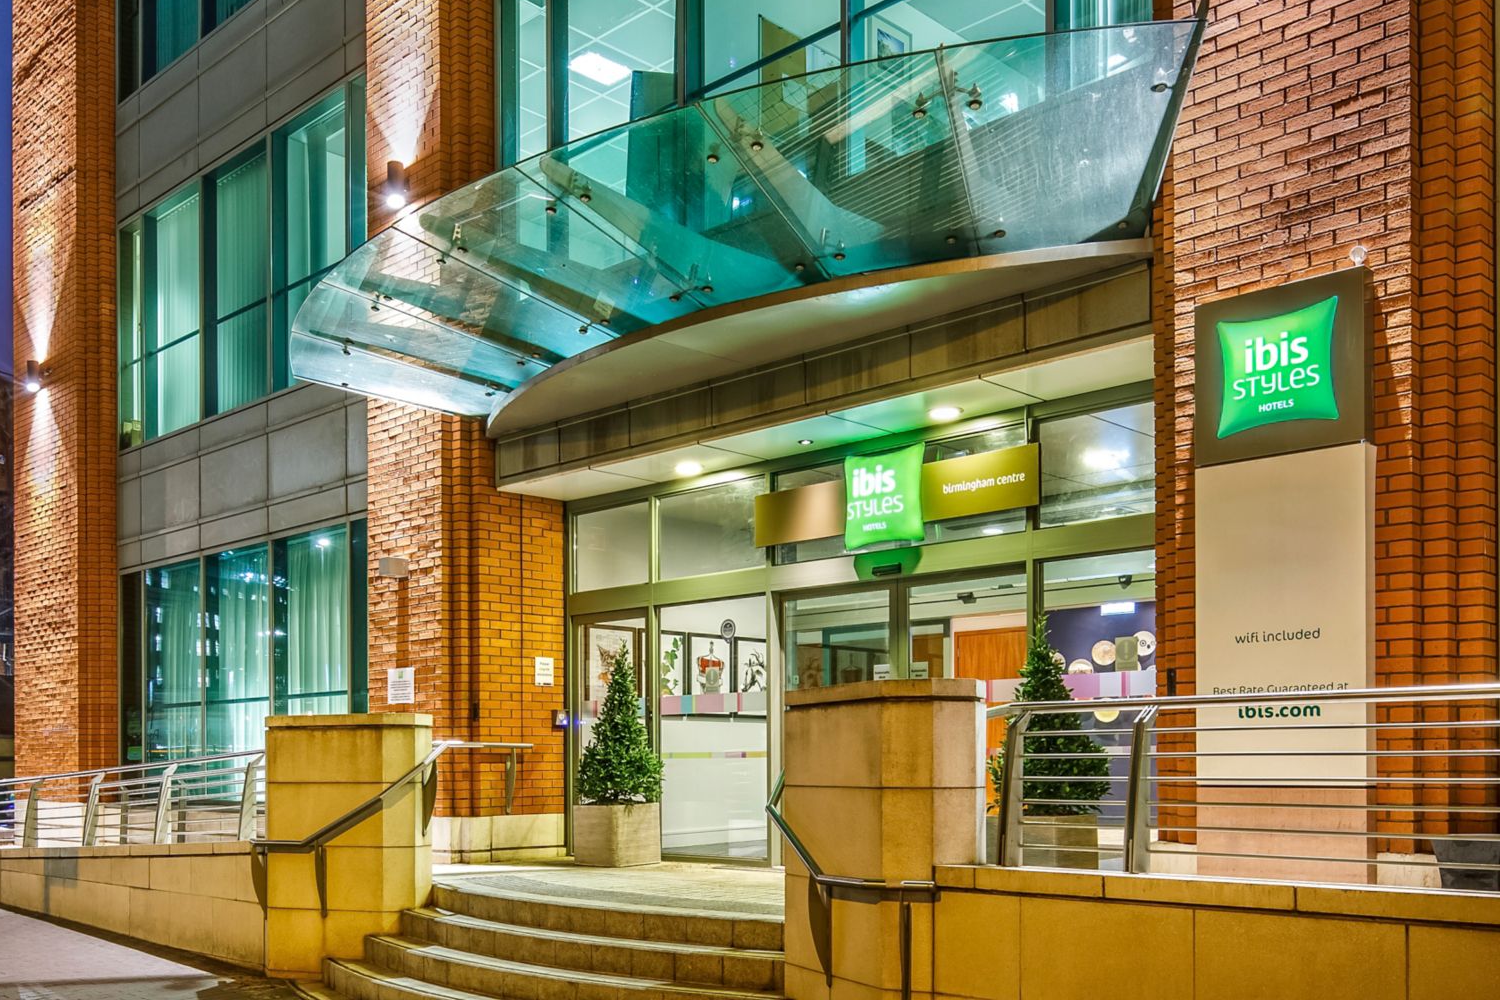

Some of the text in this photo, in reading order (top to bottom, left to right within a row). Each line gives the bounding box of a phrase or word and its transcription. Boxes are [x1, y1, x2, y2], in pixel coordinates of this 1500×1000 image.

[1244, 331, 1309, 374] ibis
[1258, 399, 1295, 413] HOTELS
[852, 464, 896, 498] ibis
[942, 472, 1026, 495] birmingham centre
[862, 521, 887, 532] HOTELS
[1234, 627, 1321, 644] wifi included
[1213, 682, 1349, 696] Best Rate Guaranteed at
[1238, 704, 1321, 719] ibis.com
